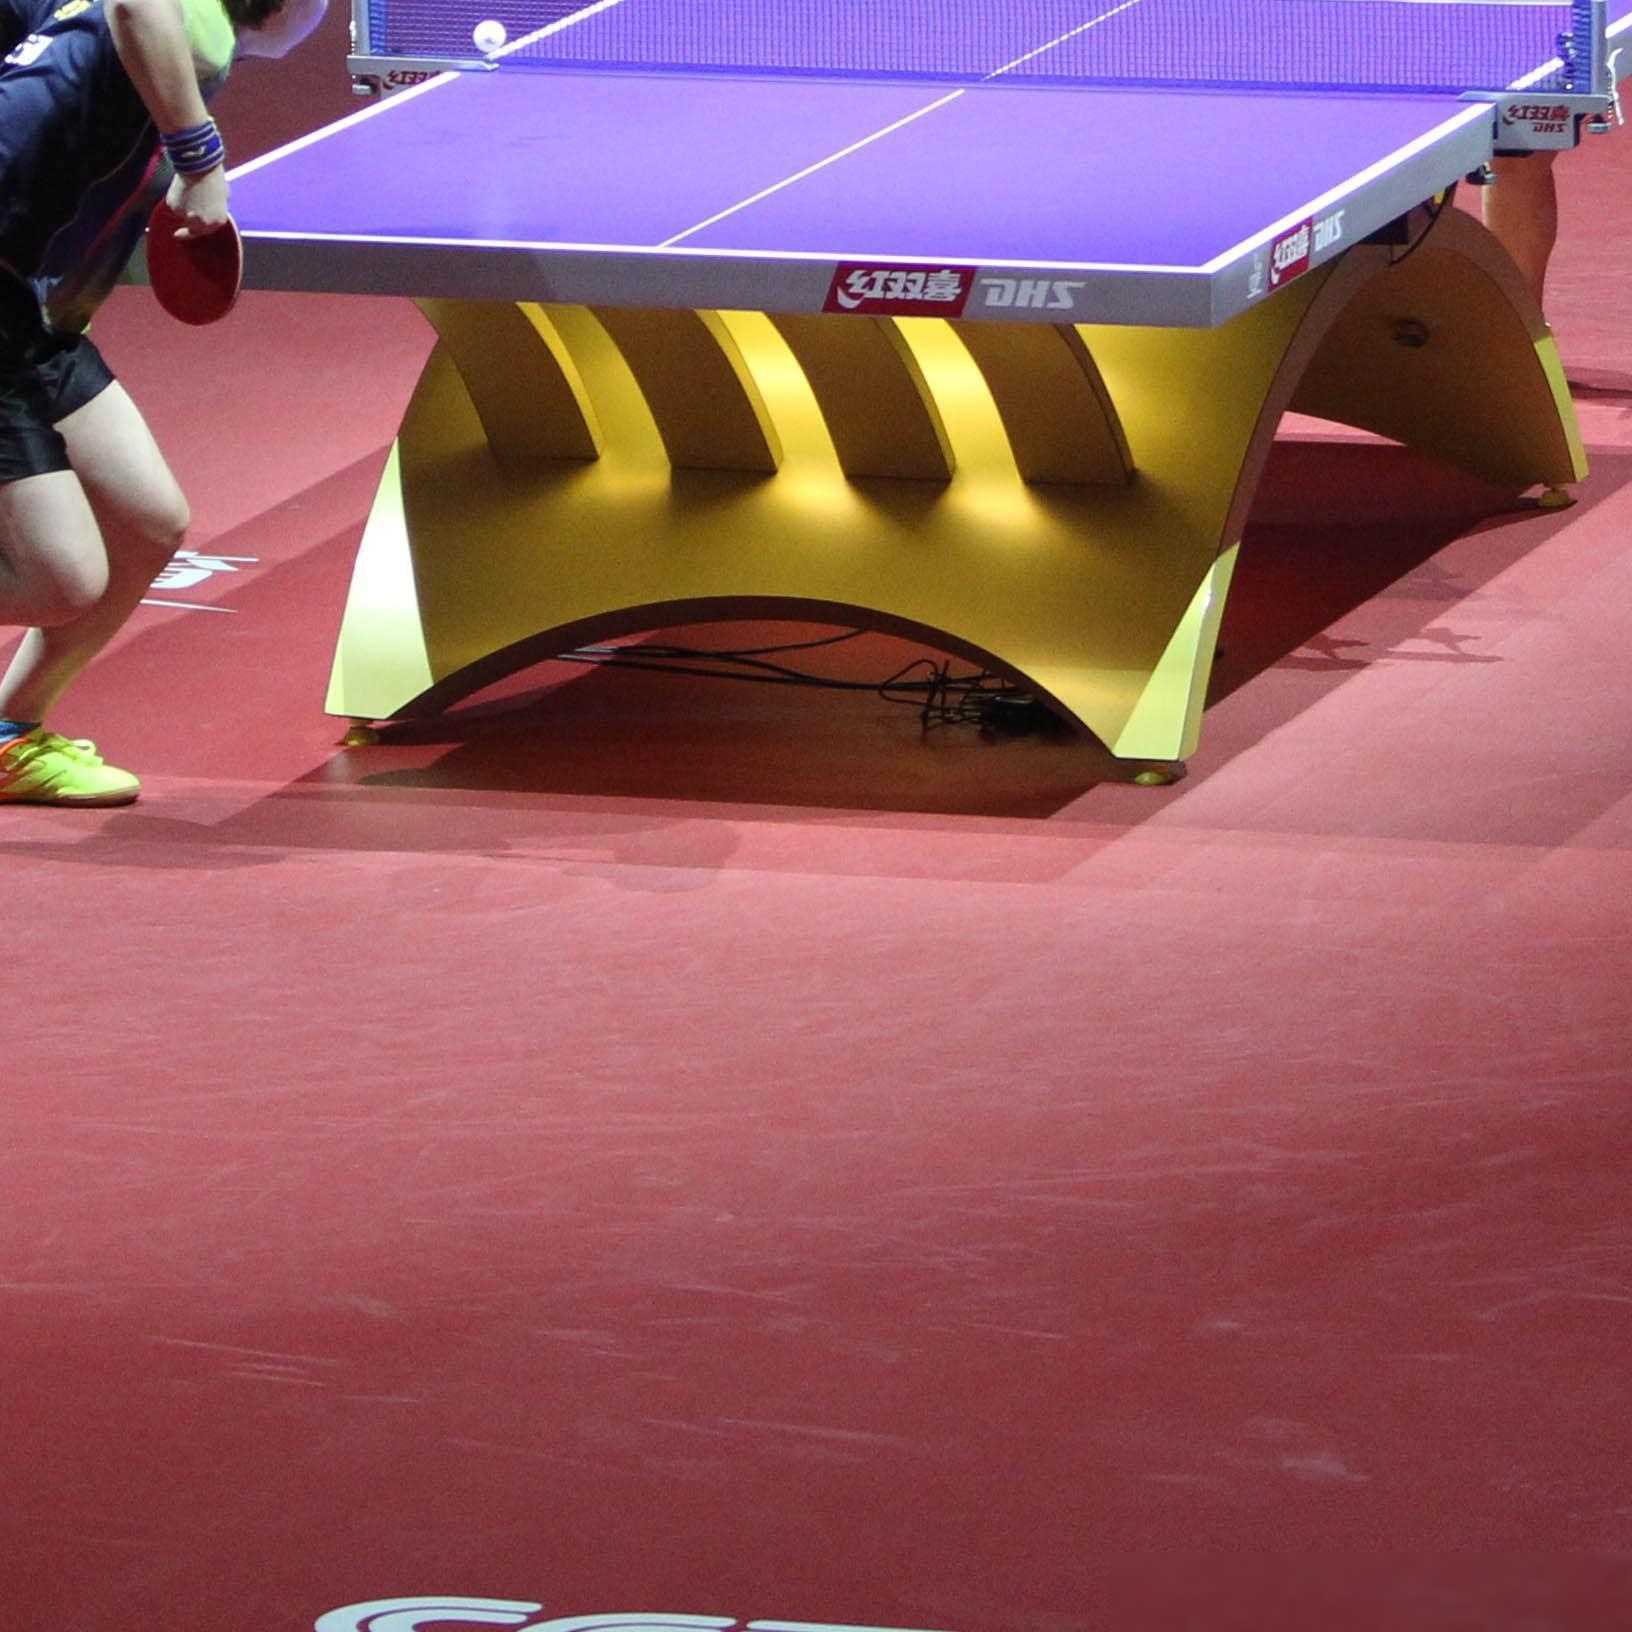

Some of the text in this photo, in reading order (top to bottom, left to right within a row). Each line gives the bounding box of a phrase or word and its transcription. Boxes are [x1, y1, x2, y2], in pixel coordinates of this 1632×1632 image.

[835, 268, 1087, 310] 红双喜 DHS
